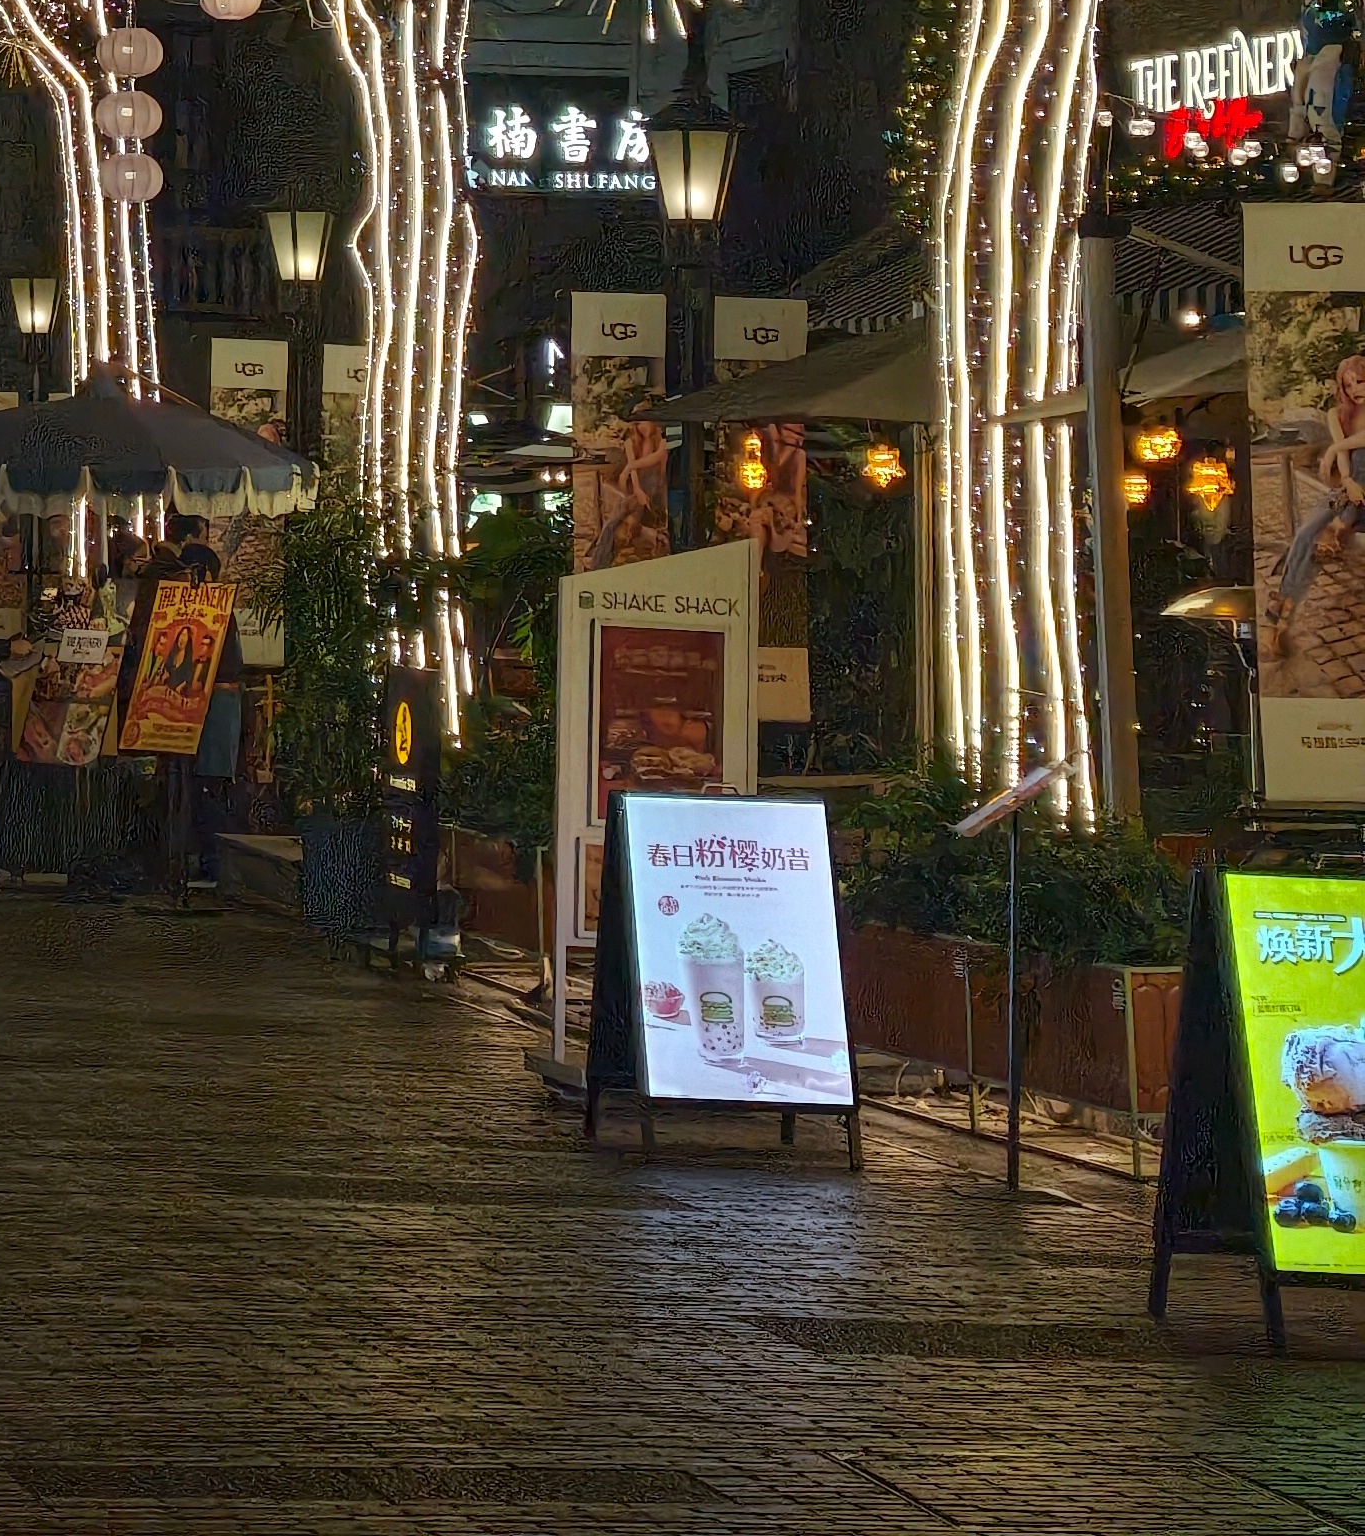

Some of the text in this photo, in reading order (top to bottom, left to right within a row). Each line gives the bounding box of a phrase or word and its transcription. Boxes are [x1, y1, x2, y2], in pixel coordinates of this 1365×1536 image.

[1130, 53, 1181, 114] THE
[554, 172, 656, 190] SHUFANG
[1289, 244, 1344, 270] UGG
[601, 322, 638, 341] UGG
[743, 326, 780, 345] UGG
[234, 362, 264, 377] UGG
[601, 591, 741, 618] SHAKE SHACK
[646, 834, 811, 873] 春日粉樱奶昔
